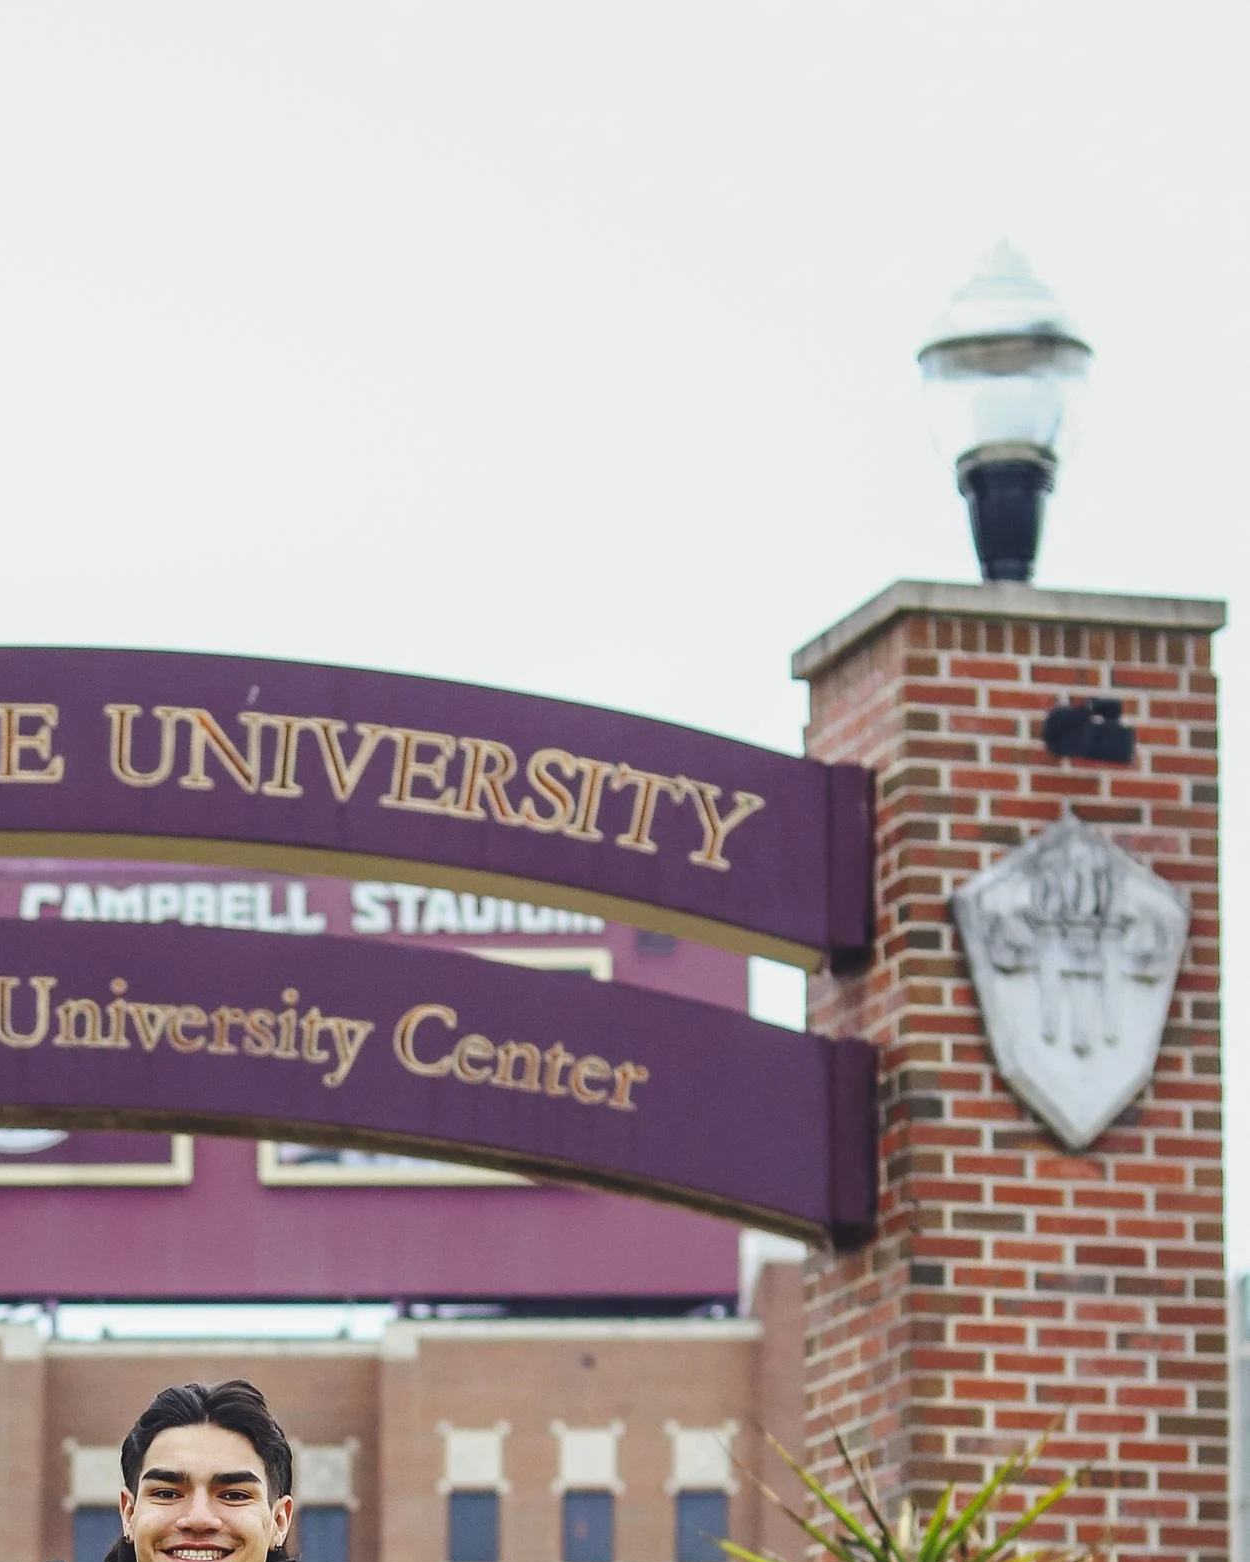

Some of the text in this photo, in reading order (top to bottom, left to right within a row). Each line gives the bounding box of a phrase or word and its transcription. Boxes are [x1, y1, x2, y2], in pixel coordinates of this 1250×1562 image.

[103, 702, 768, 873] UNIVERSITY
[19, 881, 326, 935] CAMPBELL
[393, 1004, 650, 1112] Center
